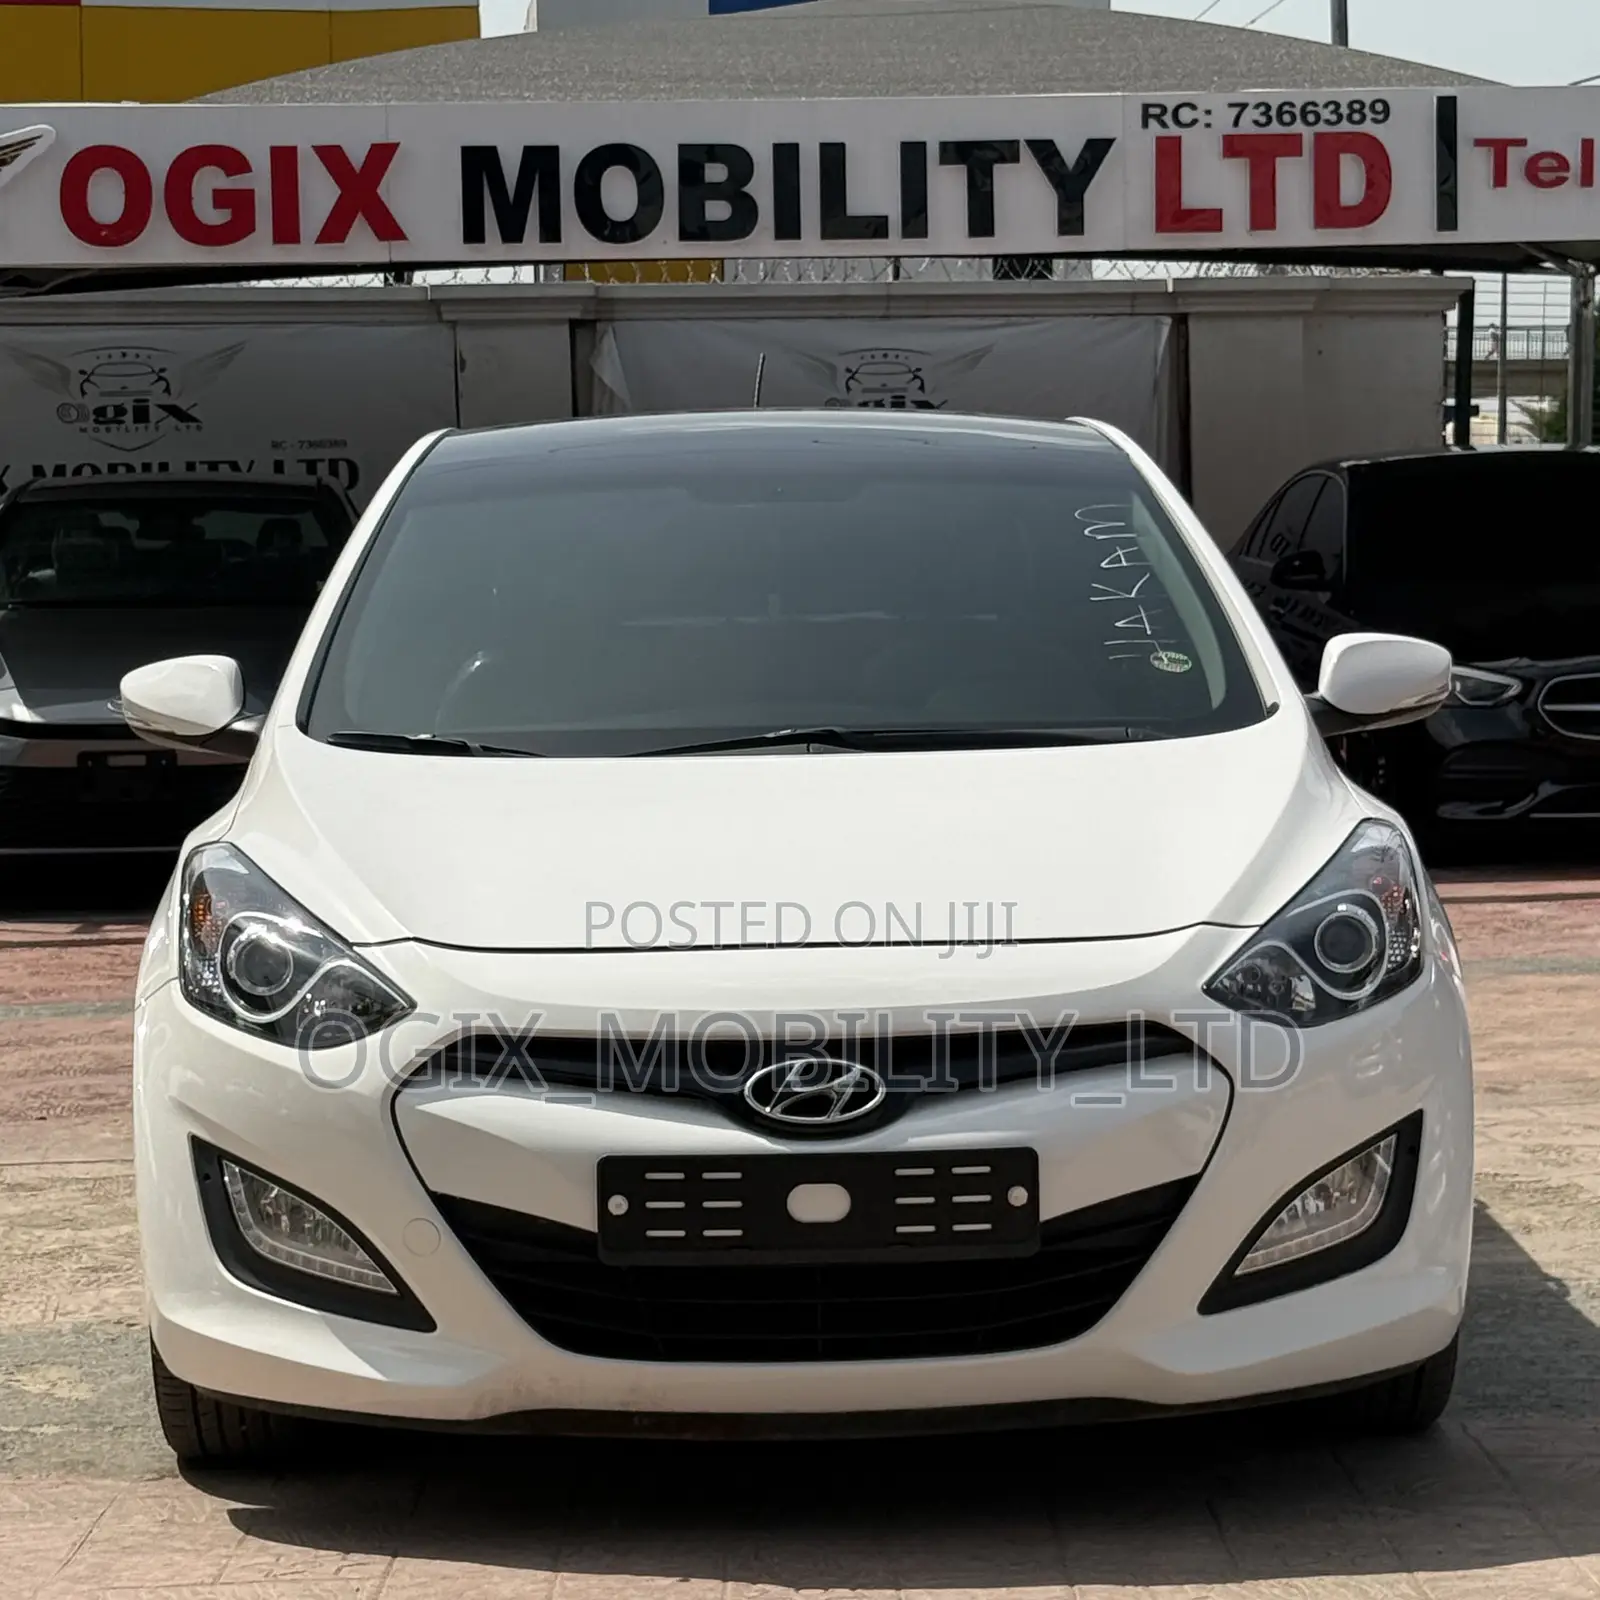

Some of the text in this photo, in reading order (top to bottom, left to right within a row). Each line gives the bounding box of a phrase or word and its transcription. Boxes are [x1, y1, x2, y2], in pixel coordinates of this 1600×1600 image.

[1141, 98, 1391, 129] RC: 7366389
[59, 131, 1393, 247] OGIX MOBILITY LTD
